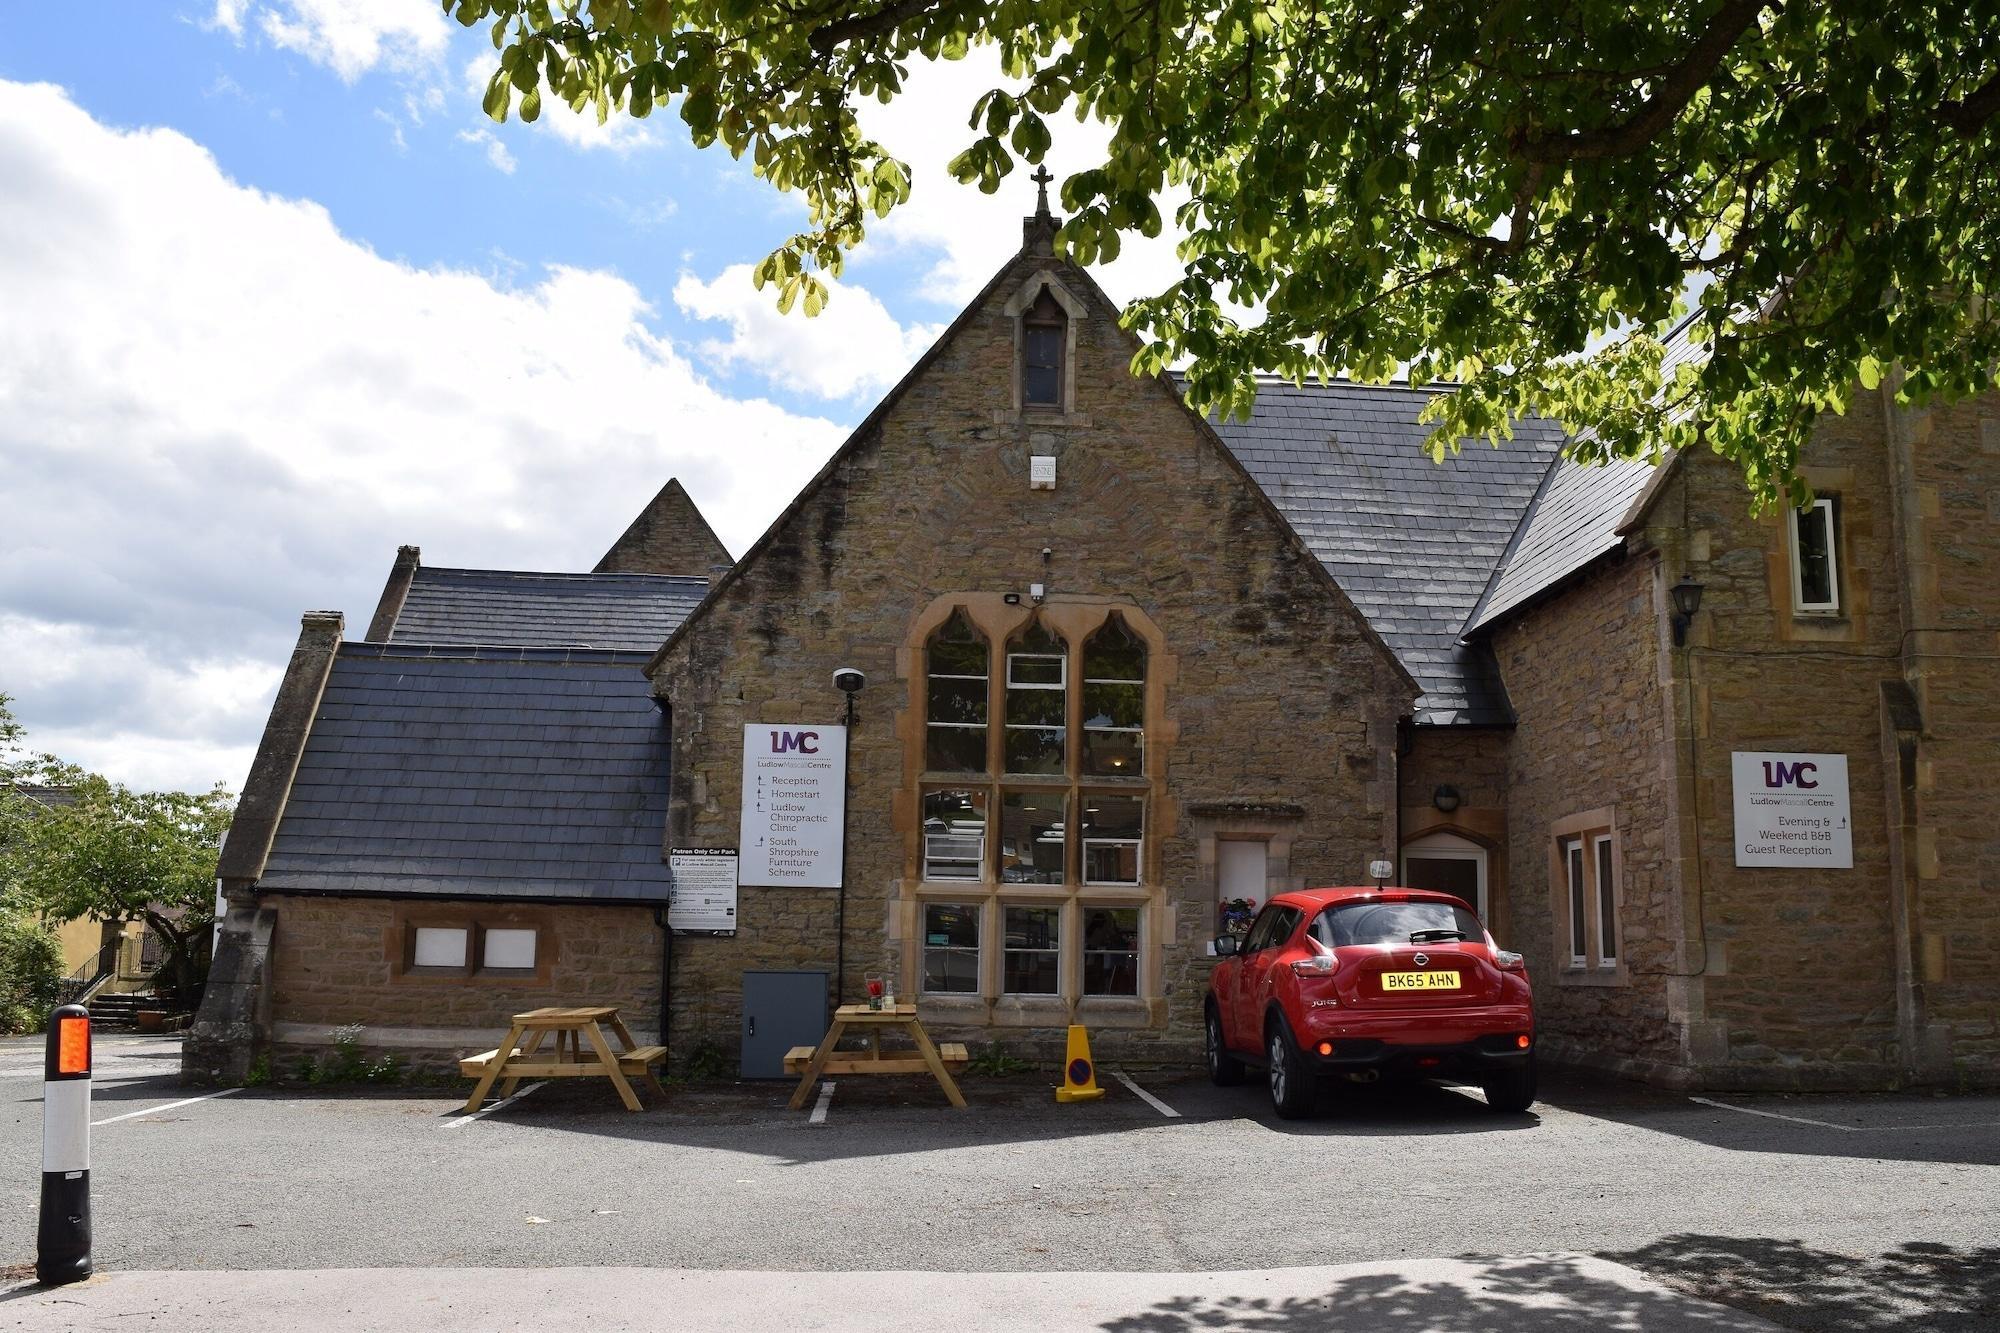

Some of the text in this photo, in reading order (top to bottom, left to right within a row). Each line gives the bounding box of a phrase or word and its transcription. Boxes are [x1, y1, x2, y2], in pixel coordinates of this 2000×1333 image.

[770, 731, 819, 754] LMC
[1762, 761, 1819, 789] LMC
[772, 776, 819, 786] Reception
[771, 789, 820, 799] Homestart
[771, 803, 805, 812] Ludlow
[770, 813, 828, 824] Chiropractic
[1778, 816, 1830, 829] Evening &
[770, 823, 797, 832] Clinic
[1759, 830, 1832, 841] Weekend B&B
[769, 838, 797, 846] South
[694, 848, 708, 856] Only
[769, 848, 819, 858] Shropshire
[1745, 844, 1832, 856] Guest Reception
[769, 858, 812, 867] Furniture
[768, 868, 806, 877] Scheme
[1388, 974, 1454, 988] BK65 AHN
